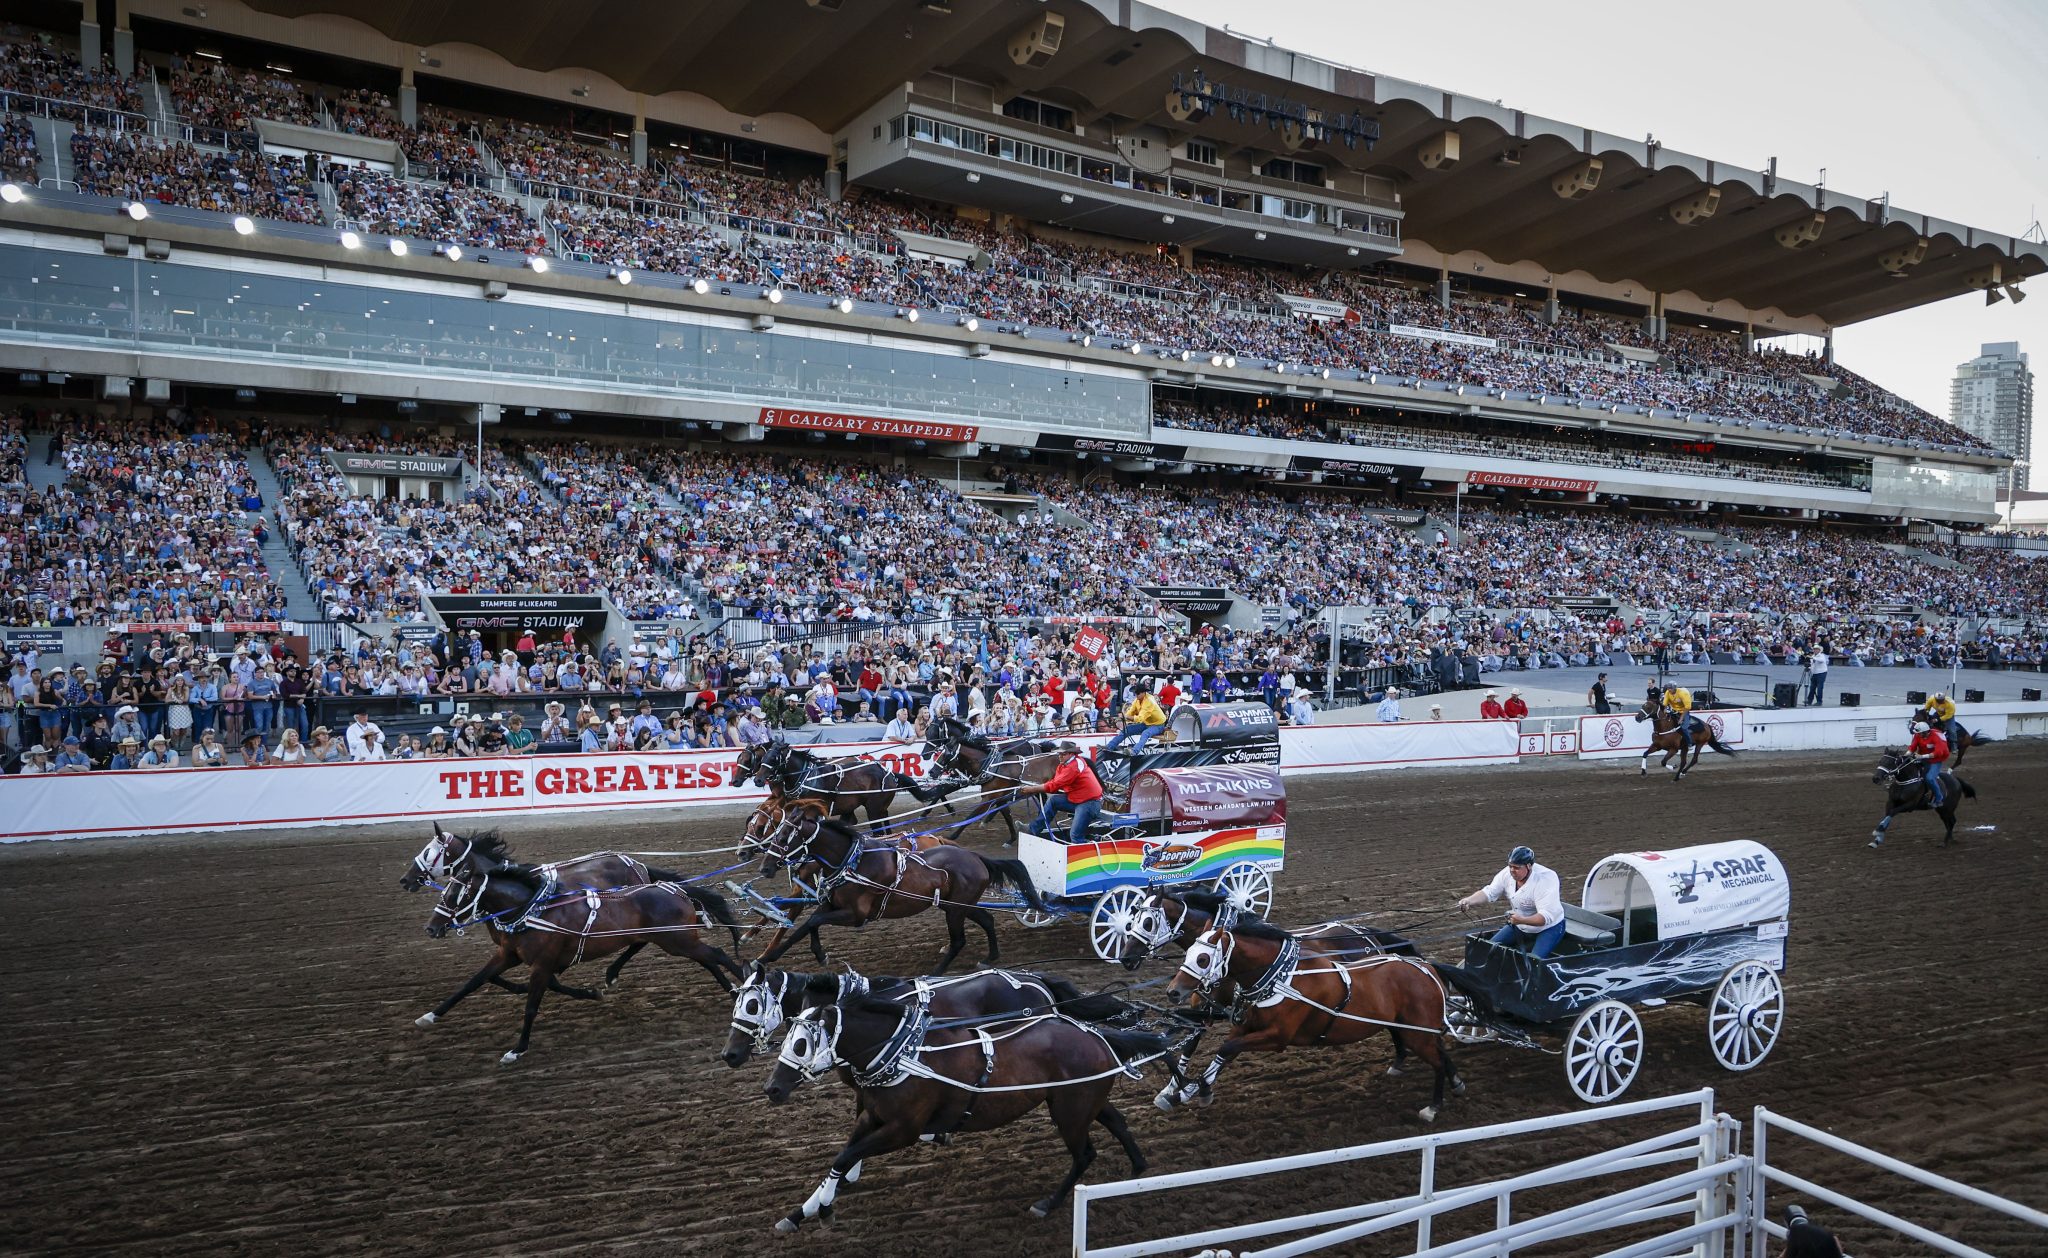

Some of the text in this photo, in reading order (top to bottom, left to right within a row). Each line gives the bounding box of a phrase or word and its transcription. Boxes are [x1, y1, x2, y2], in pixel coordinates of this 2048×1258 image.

[1316, 304, 1342, 314] cenovus
[789, 414, 953, 437] CALGARY STAMPEDE
[1074, 439, 1154, 455] GMC STADIUM
[347, 458, 446, 472] GMC STADIUM
[1322, 461, 1394, 474] GMC STADIUM
[1484, 474, 1582, 489] CALGARY STAMPEDE
[1186, 602, 1220, 610] STADIUM
[457, 616, 584, 627] GMC STADIUM
[1080, 634, 1092, 649] GET
[1226, 708, 1271, 718] SUMMIT
[1242, 716, 1273, 725] FLEET
[1239, 751, 1278, 762] Signarama
[439, 770, 524, 799] THE
[1178, 779, 1272, 795] MLT AIKINS
[1184, 805, 1213, 813] WESTERN
[1160, 848, 1200, 861] Scorpion
[1713, 854, 1767, 878] GRAF
[1721, 874, 1775, 889] MECHANICAL
